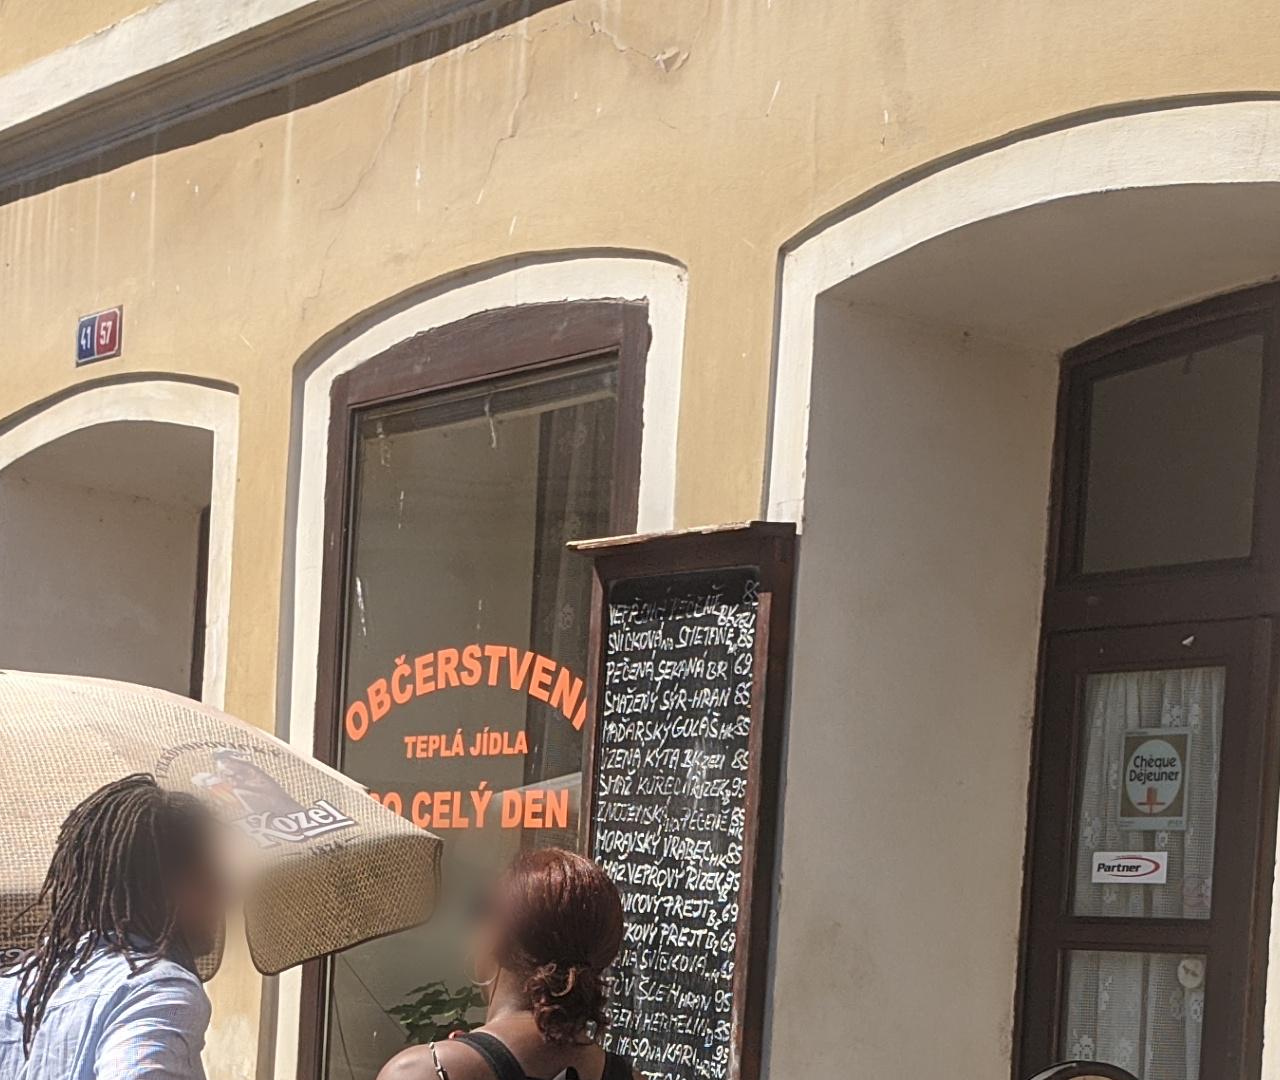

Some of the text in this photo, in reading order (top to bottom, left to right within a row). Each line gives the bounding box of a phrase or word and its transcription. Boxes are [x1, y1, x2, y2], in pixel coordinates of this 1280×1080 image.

[81, 321, 112, 350] 41 57
[606, 650, 656, 685] PEČENÁ
[654, 650, 707, 681] SEKANÁ
[604, 681, 661, 716] SMAŽENÝ
[404, 726, 528, 759] TEPLÁ JÍDLA
[412, 781, 493, 828] CELÝ
[501, 789, 568, 828] DEN
[232, 799, 359, 850] Kozel
[664, 835, 713, 861] VRABEC
[1096, 862, 1142, 873] Partner
[722, 904, 738, 923] 69
[659, 922, 707, 947] PREJT
[721, 929, 736, 953] 69
